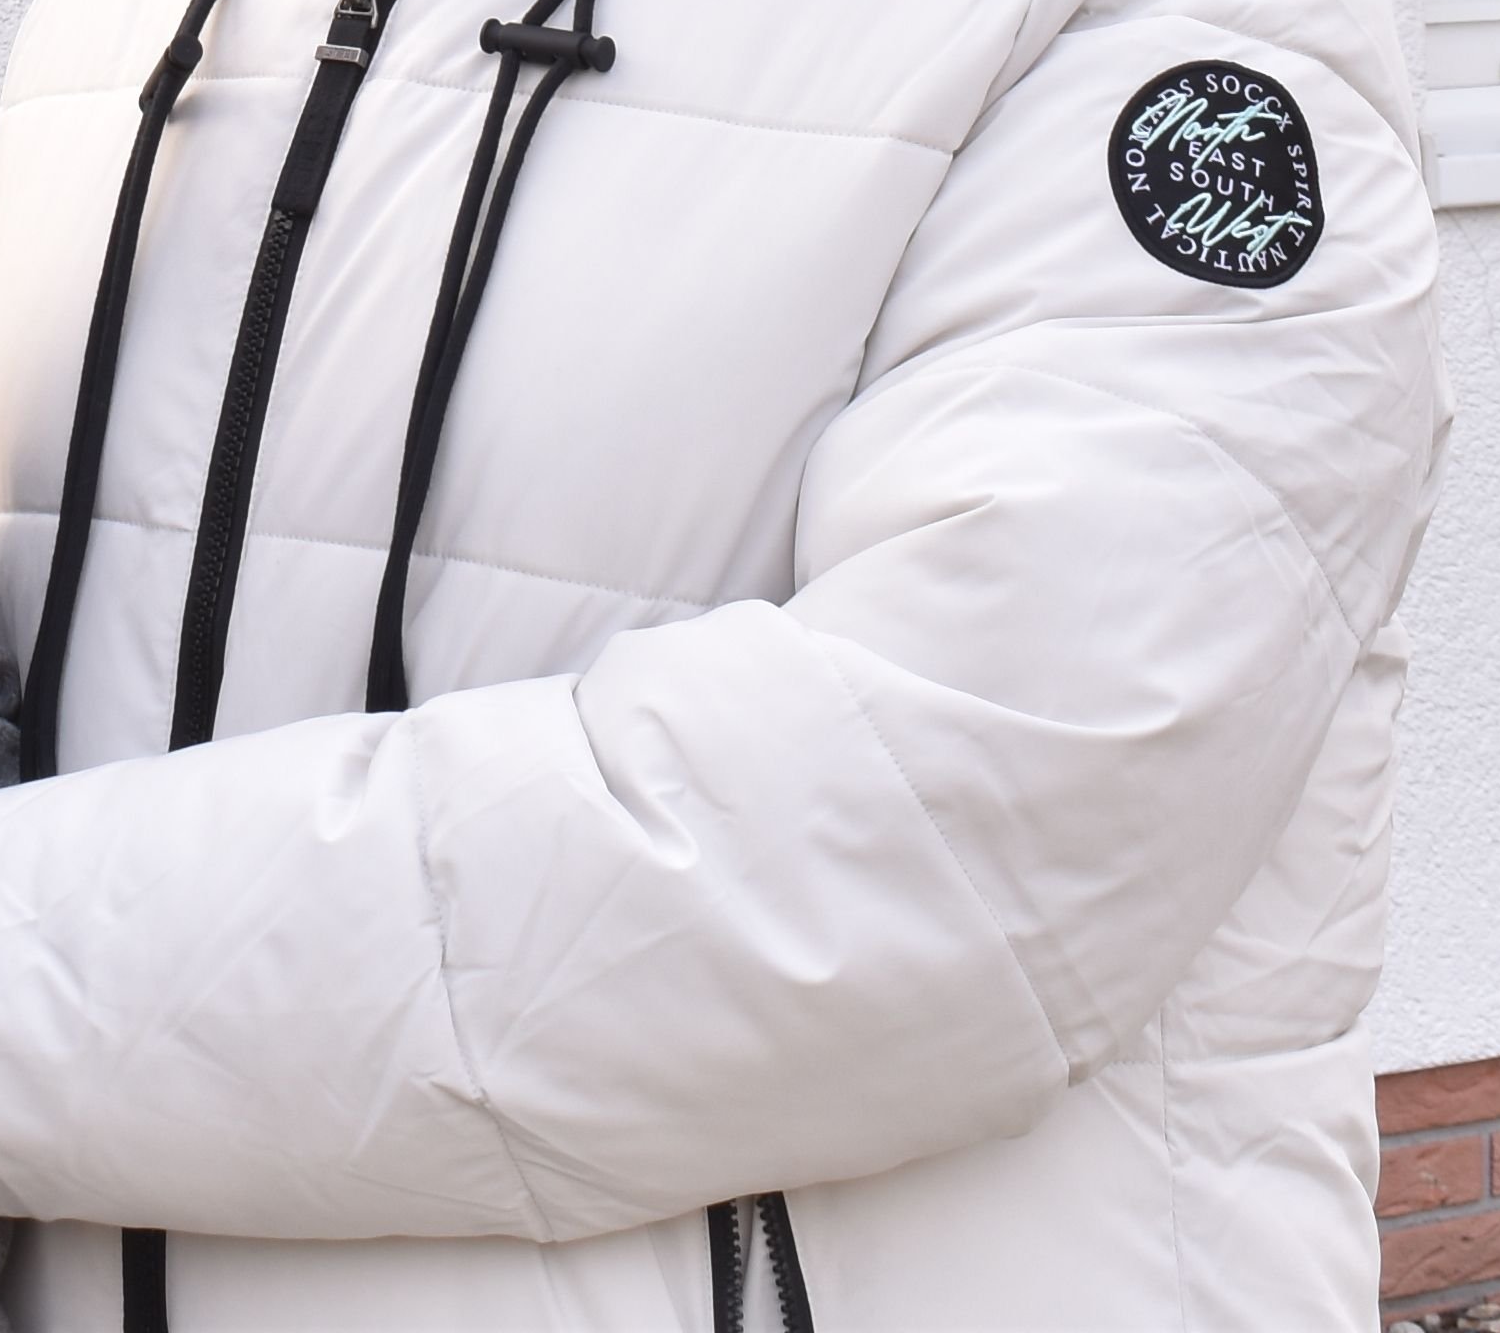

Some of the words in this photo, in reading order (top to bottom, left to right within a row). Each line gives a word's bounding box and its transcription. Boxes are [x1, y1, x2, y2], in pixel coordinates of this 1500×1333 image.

[1205, 73, 1294, 133] SOCCX
[1187, 140, 1266, 178] EAST
[1169, 161, 1275, 213] SOUTH
